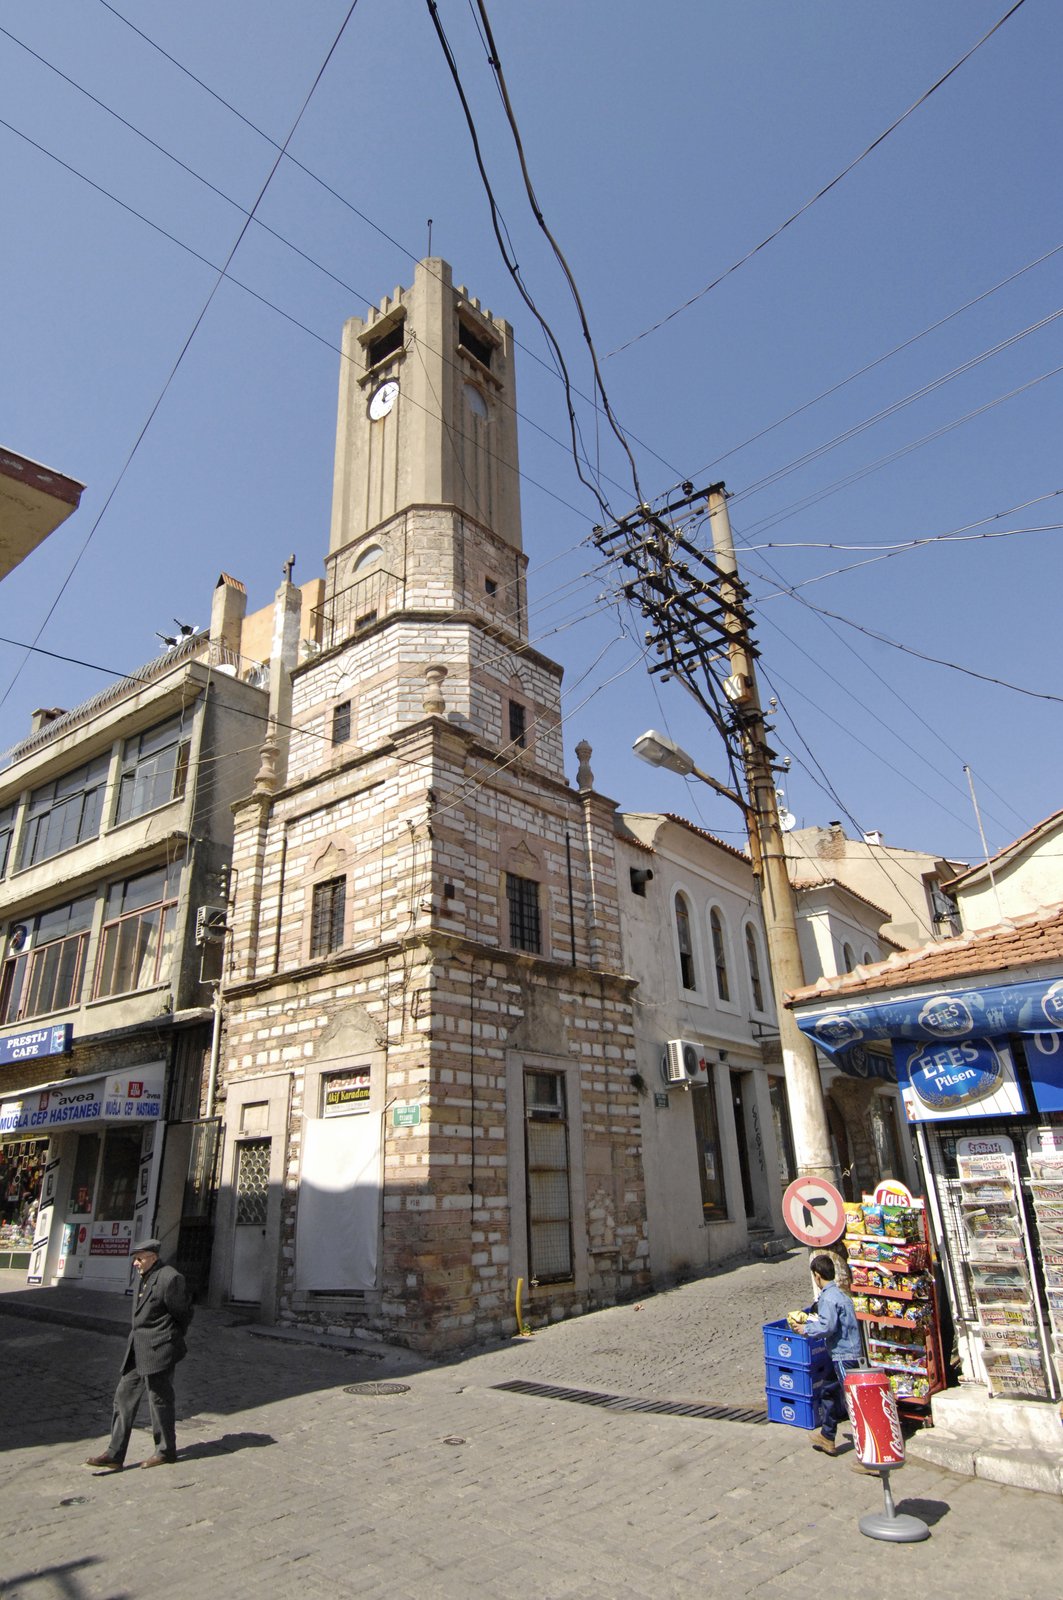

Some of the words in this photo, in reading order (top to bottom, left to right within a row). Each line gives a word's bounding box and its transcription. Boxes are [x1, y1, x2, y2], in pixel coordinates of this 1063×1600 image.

[927, 1004, 959, 1026] EFES
[6, 1030, 49, 1049] PRESTİJ
[12, 1044, 39, 1058] CAFE
[918, 1040, 979, 1080] EFES
[934, 1068, 977, 1092] Pilsen
[58, 1092, 95, 1106] avea
[328, 1090, 341, 1104] Akif
[0, 1111, 28, 1130] MUĞLA
[31, 1110, 48, 1126] CEP
[49, 1101, 102, 1123] HASTANESİ
[105, 1099, 120, 1116] MUĞLA
[124, 1101, 134, 1116] CEP
[136, 1101, 160, 1117] HASTANESİ
[968, 1142, 1001, 1156] SABAH
